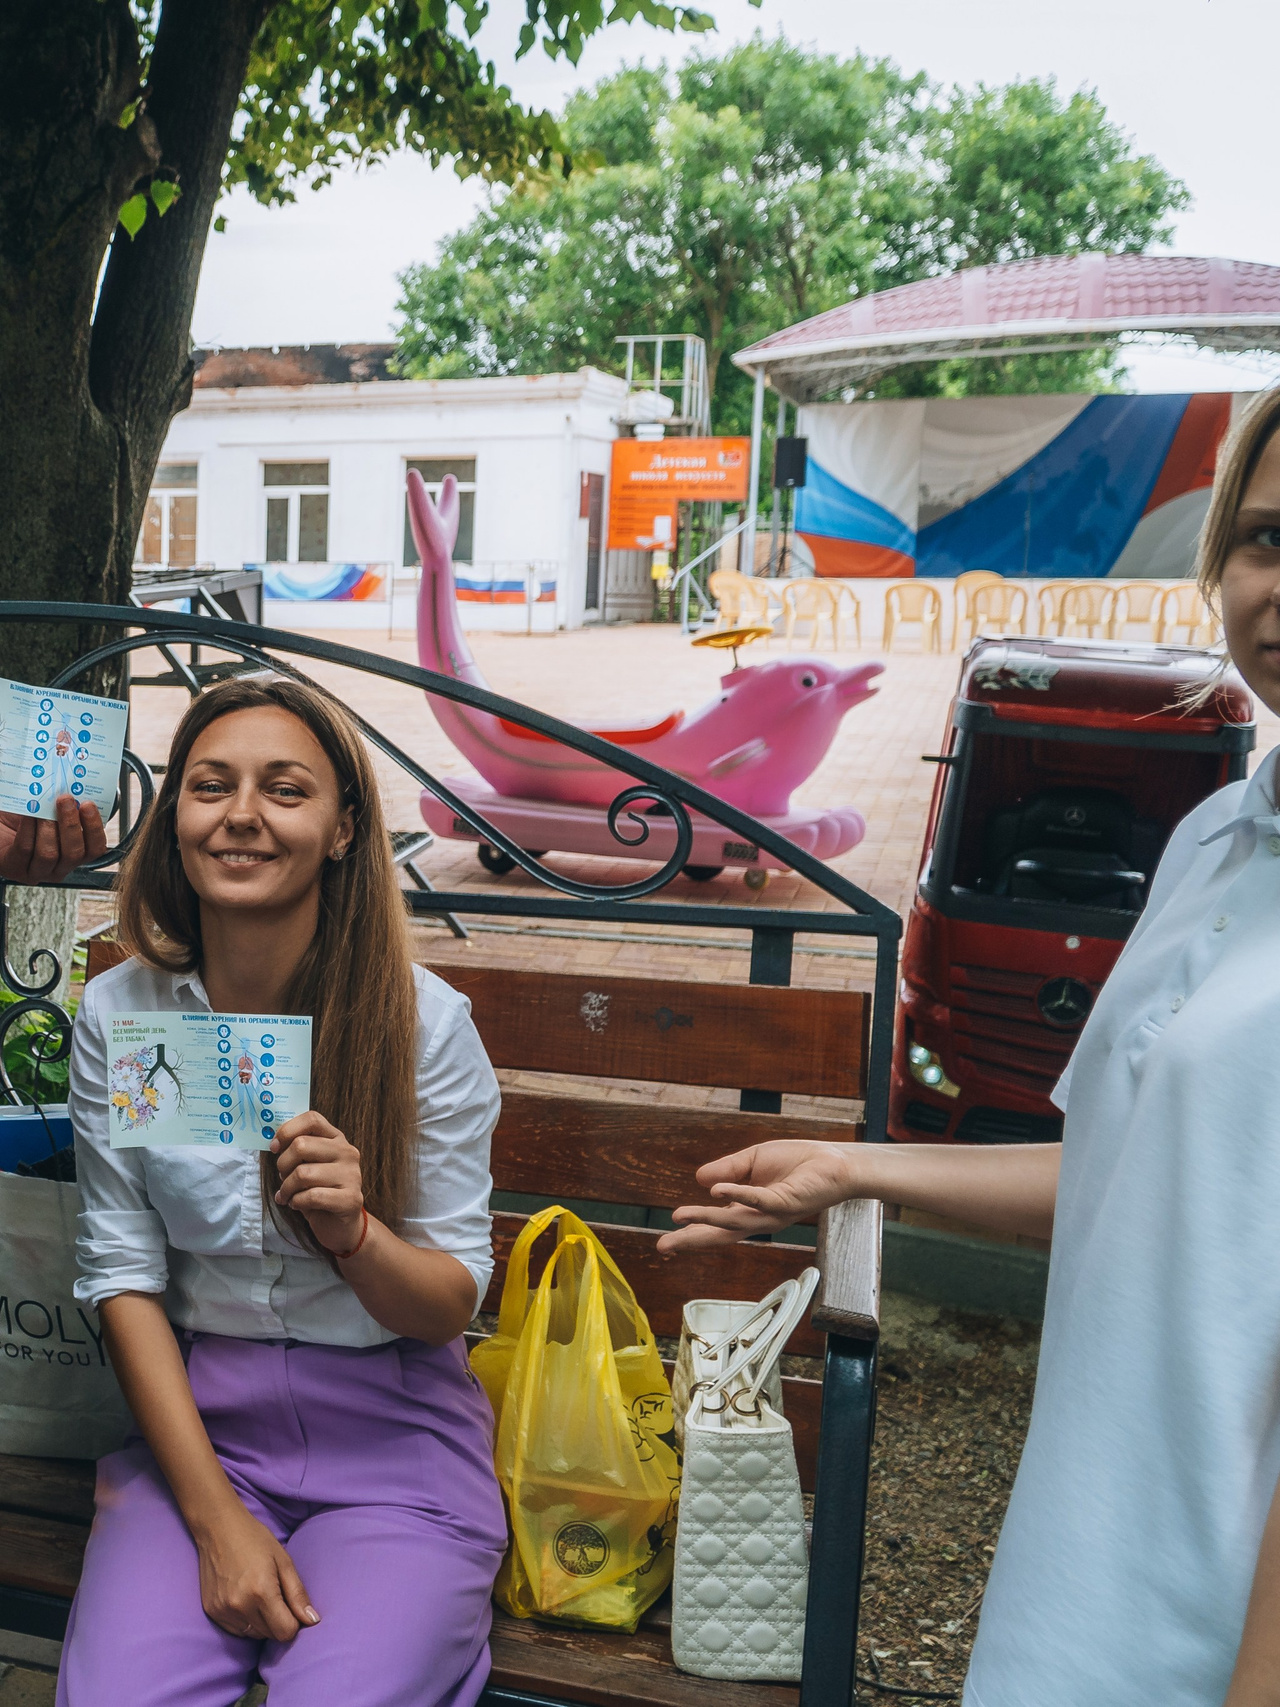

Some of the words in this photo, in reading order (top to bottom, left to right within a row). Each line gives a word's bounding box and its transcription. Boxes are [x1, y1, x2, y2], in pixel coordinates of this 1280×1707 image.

[35, 689, 62, 699] КУРЕНИЯ
[99, 700, 128, 711] ЧЕЛОВЕКА
[182, 1014, 210, 1022] ВЛИЯНИЕ
[211, 1015, 238, 1023] КУРЕНИЯ
[238, 1016, 247, 1024] НА
[248, 1017, 279, 1025] ОРГАНИЗМ
[279, 1018, 310, 1026] ЧЕЛОВЕКА
[112, 1027, 150, 1035] ВСЕМИРНЫЙ
[43, 1348, 91, 1367] YOU
